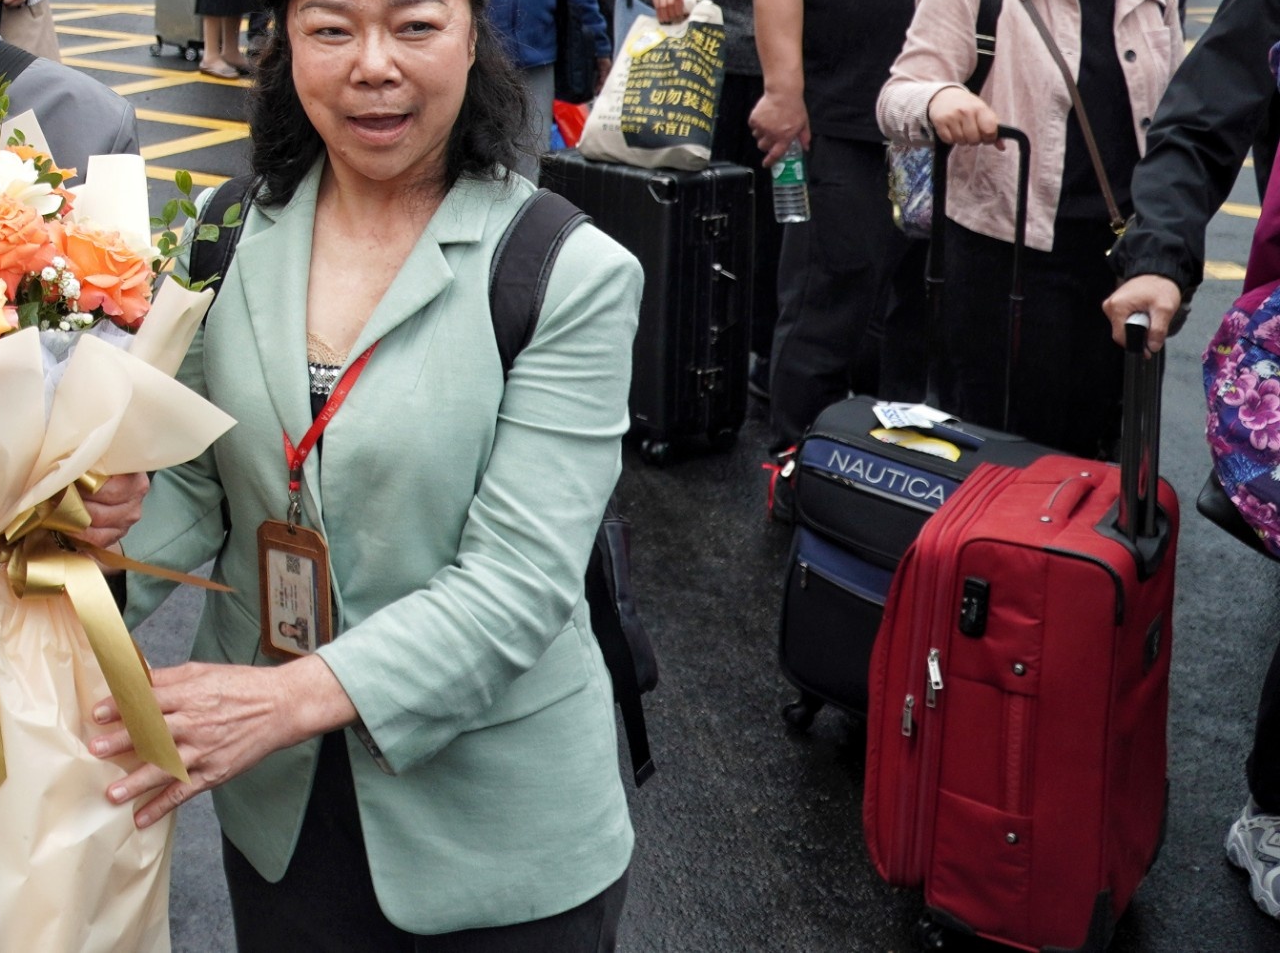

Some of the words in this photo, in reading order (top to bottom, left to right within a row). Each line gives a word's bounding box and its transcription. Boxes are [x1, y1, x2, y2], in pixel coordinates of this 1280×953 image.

[652, 121, 691, 137] 不盲目
[827, 449, 946, 505] NAUTICA
